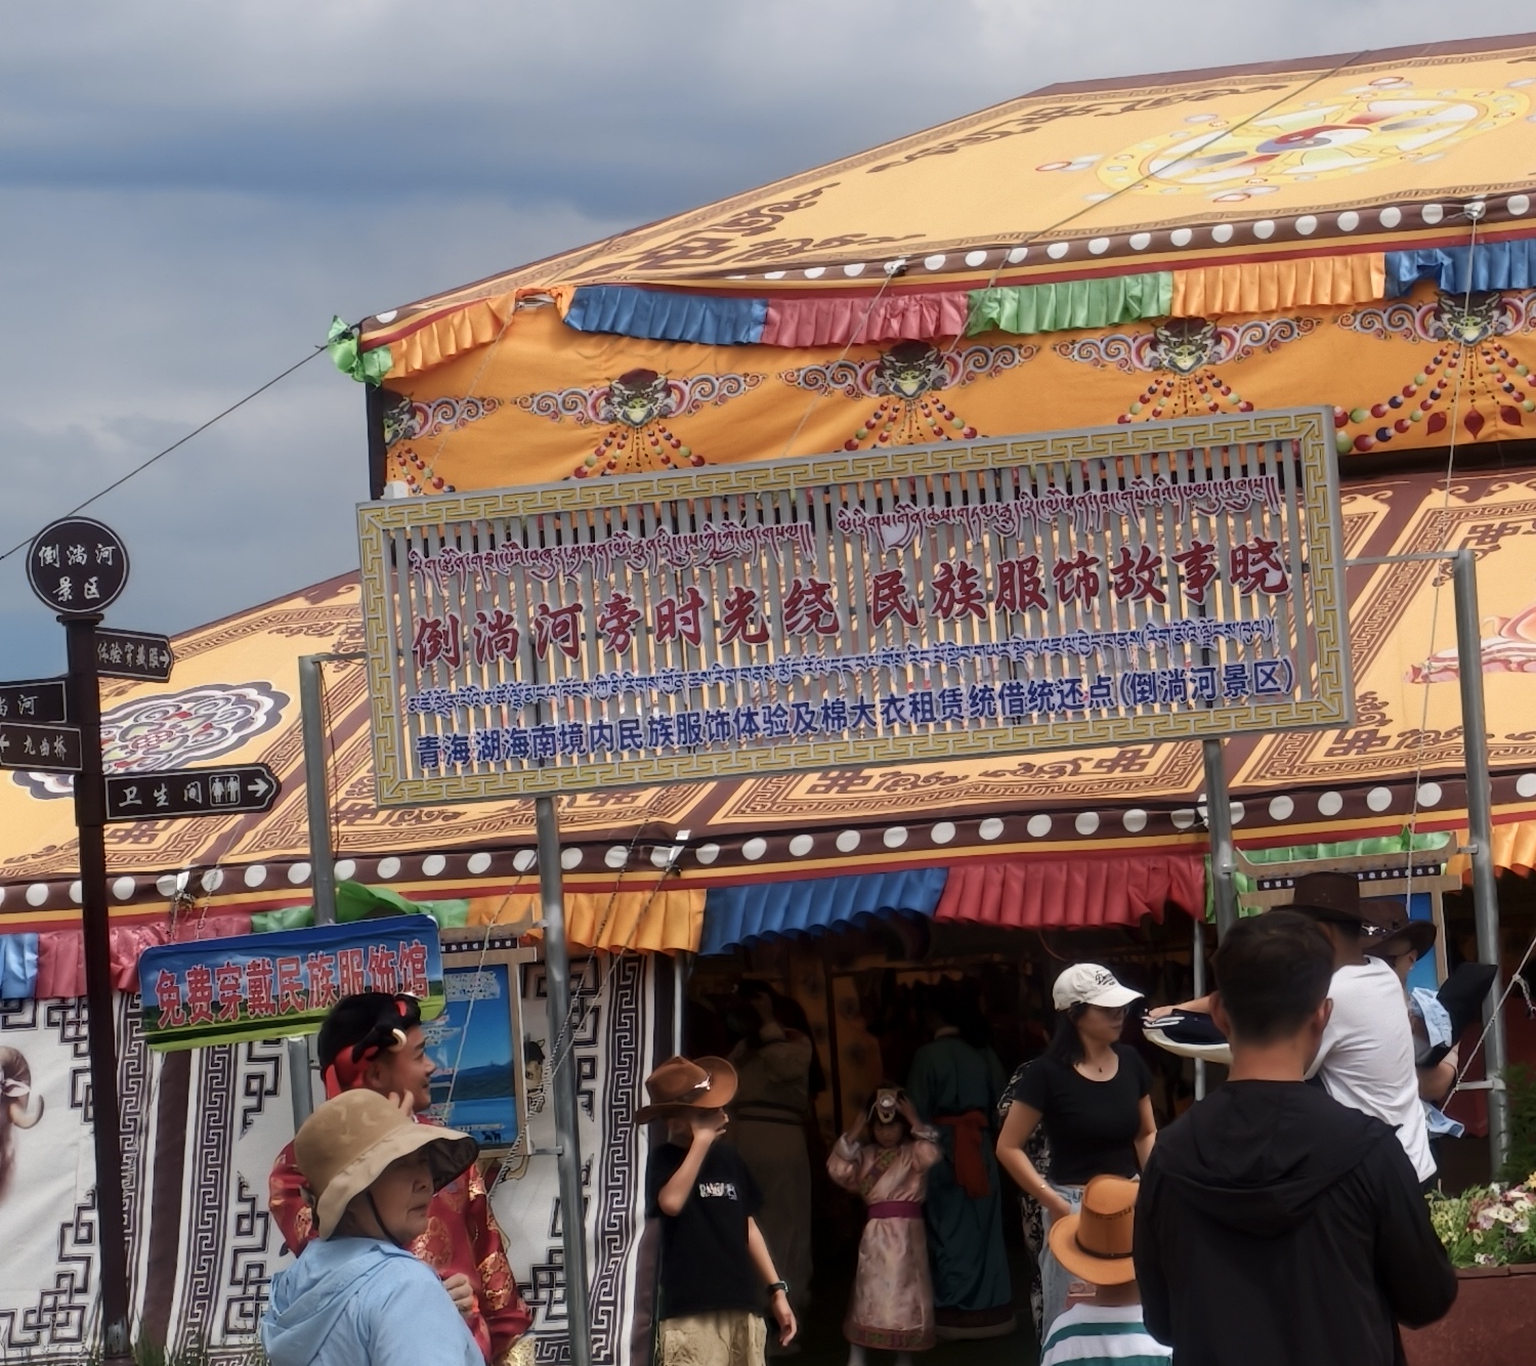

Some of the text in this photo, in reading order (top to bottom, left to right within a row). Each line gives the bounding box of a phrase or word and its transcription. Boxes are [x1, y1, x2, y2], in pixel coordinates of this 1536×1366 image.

[38, 544, 116, 568] 倒淌河
[52, 576, 101, 602] 景区
[412, 577, 843, 672] 倒淌河旁时光绕
[869, 535, 1293, 629] 民族服饰故事晓
[416, 657, 1294, 769] 青海湖海南境内民族服饰体验及棉大衣租赁统借统还点(倒淌河景区)
[118, 782, 204, 808] 卫生间
[155, 939, 430, 1030] 免费穿戴民族服饰馆
